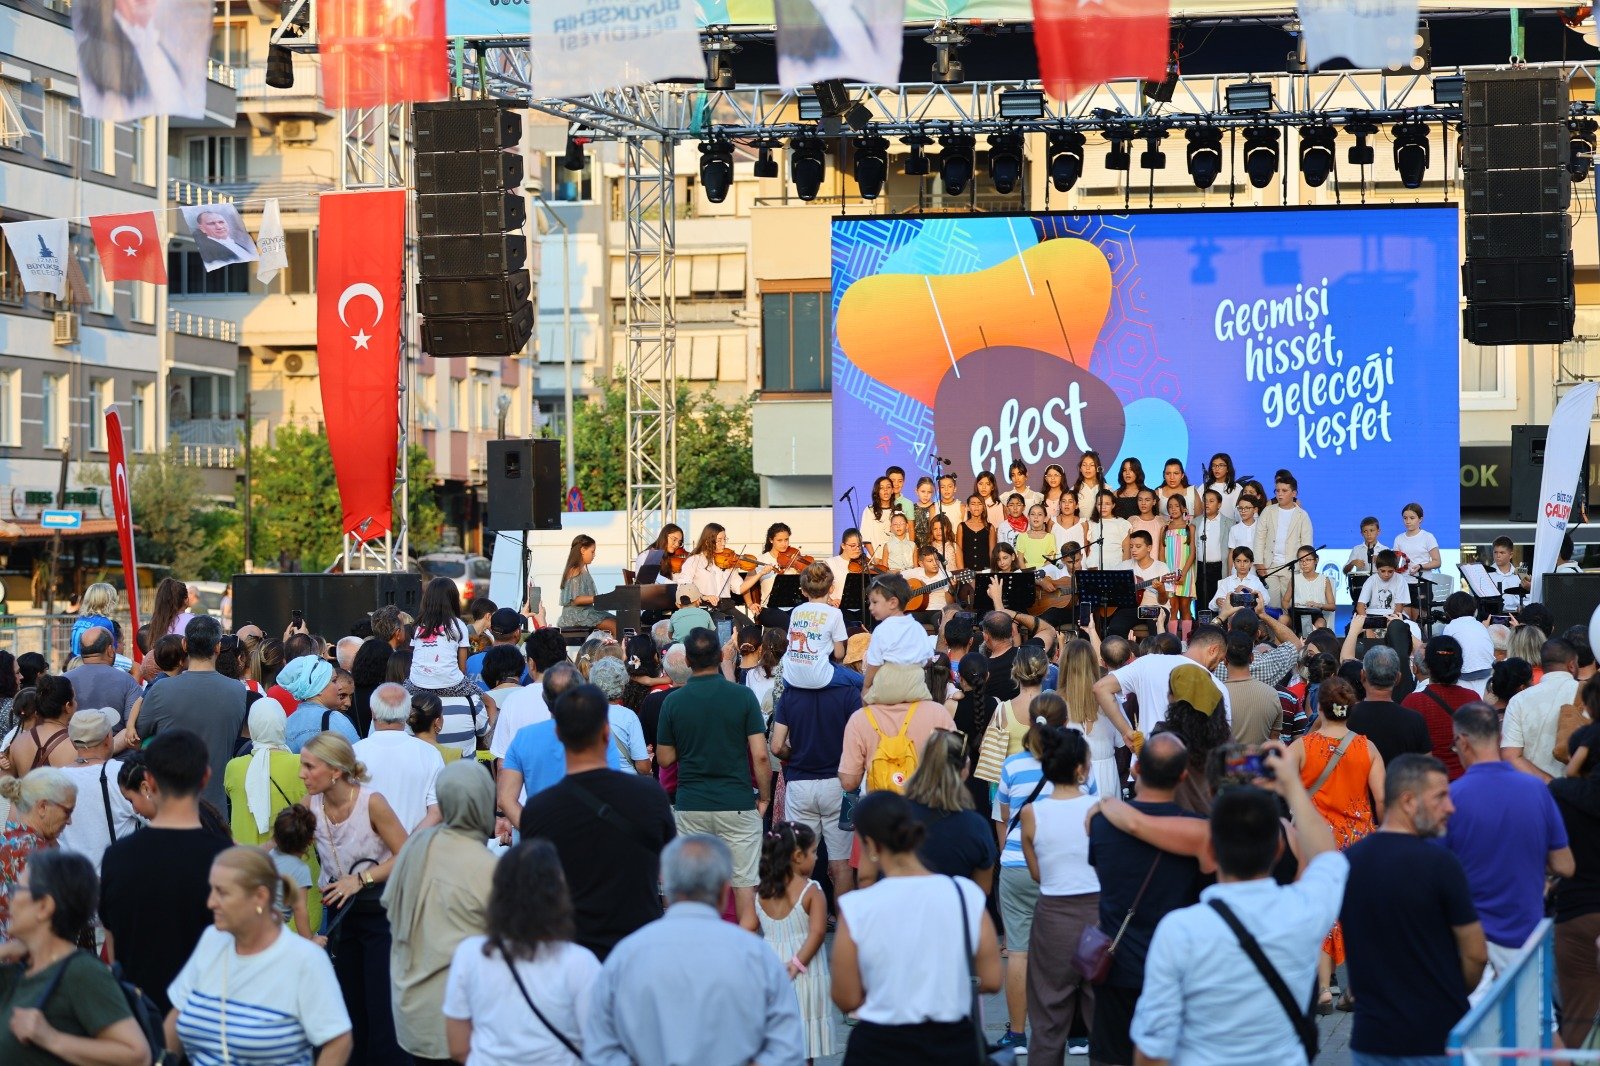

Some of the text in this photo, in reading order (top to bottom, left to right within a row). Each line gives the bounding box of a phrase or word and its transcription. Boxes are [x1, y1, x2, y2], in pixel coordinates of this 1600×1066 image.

[1214, 277, 1329, 342] Geçmişi
[1245, 324, 1343, 382] hisset,
[1262, 346, 1394, 428] geleceği
[970, 381, 1092, 484] efest
[1298, 400, 1392, 459] keşfet
